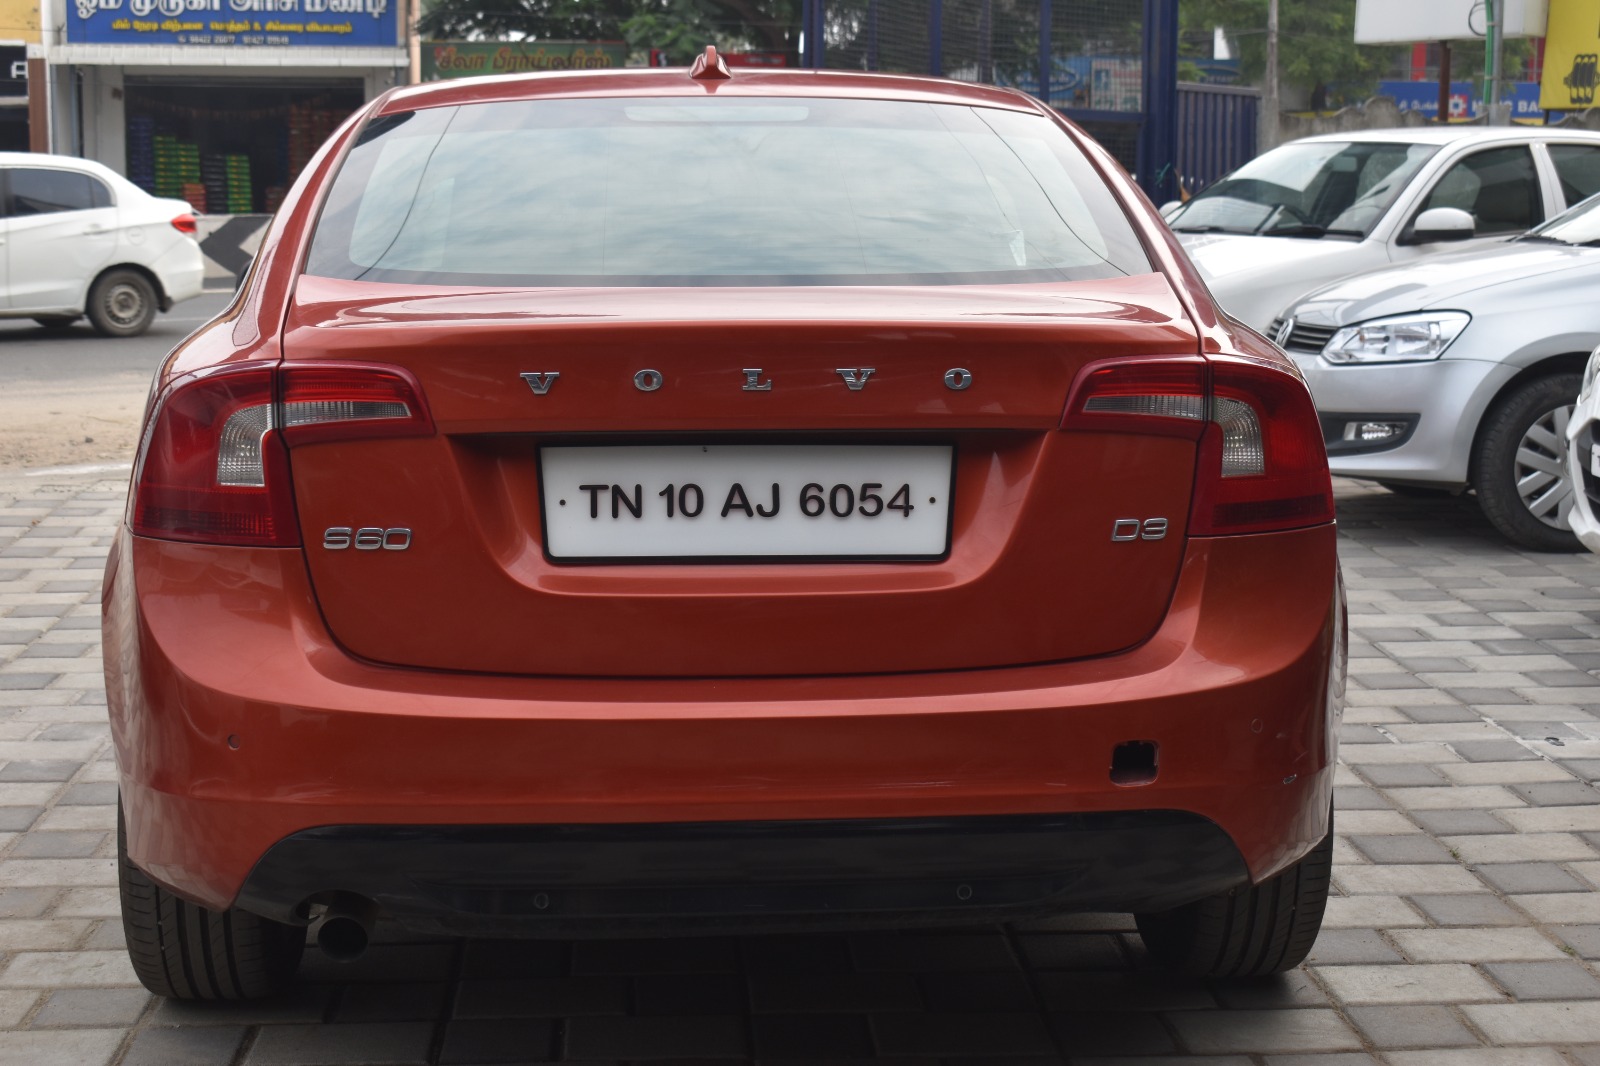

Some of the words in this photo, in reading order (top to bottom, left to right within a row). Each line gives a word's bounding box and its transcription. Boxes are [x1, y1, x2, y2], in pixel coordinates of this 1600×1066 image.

[519, 367, 973, 396] VOLVO
[579, 483, 643, 519] TN
[658, 483, 705, 519] 10
[720, 482, 781, 518] AJ
[799, 482, 915, 518] 6054
[323, 526, 412, 551] S60
[1111, 517, 1168, 542] D3
